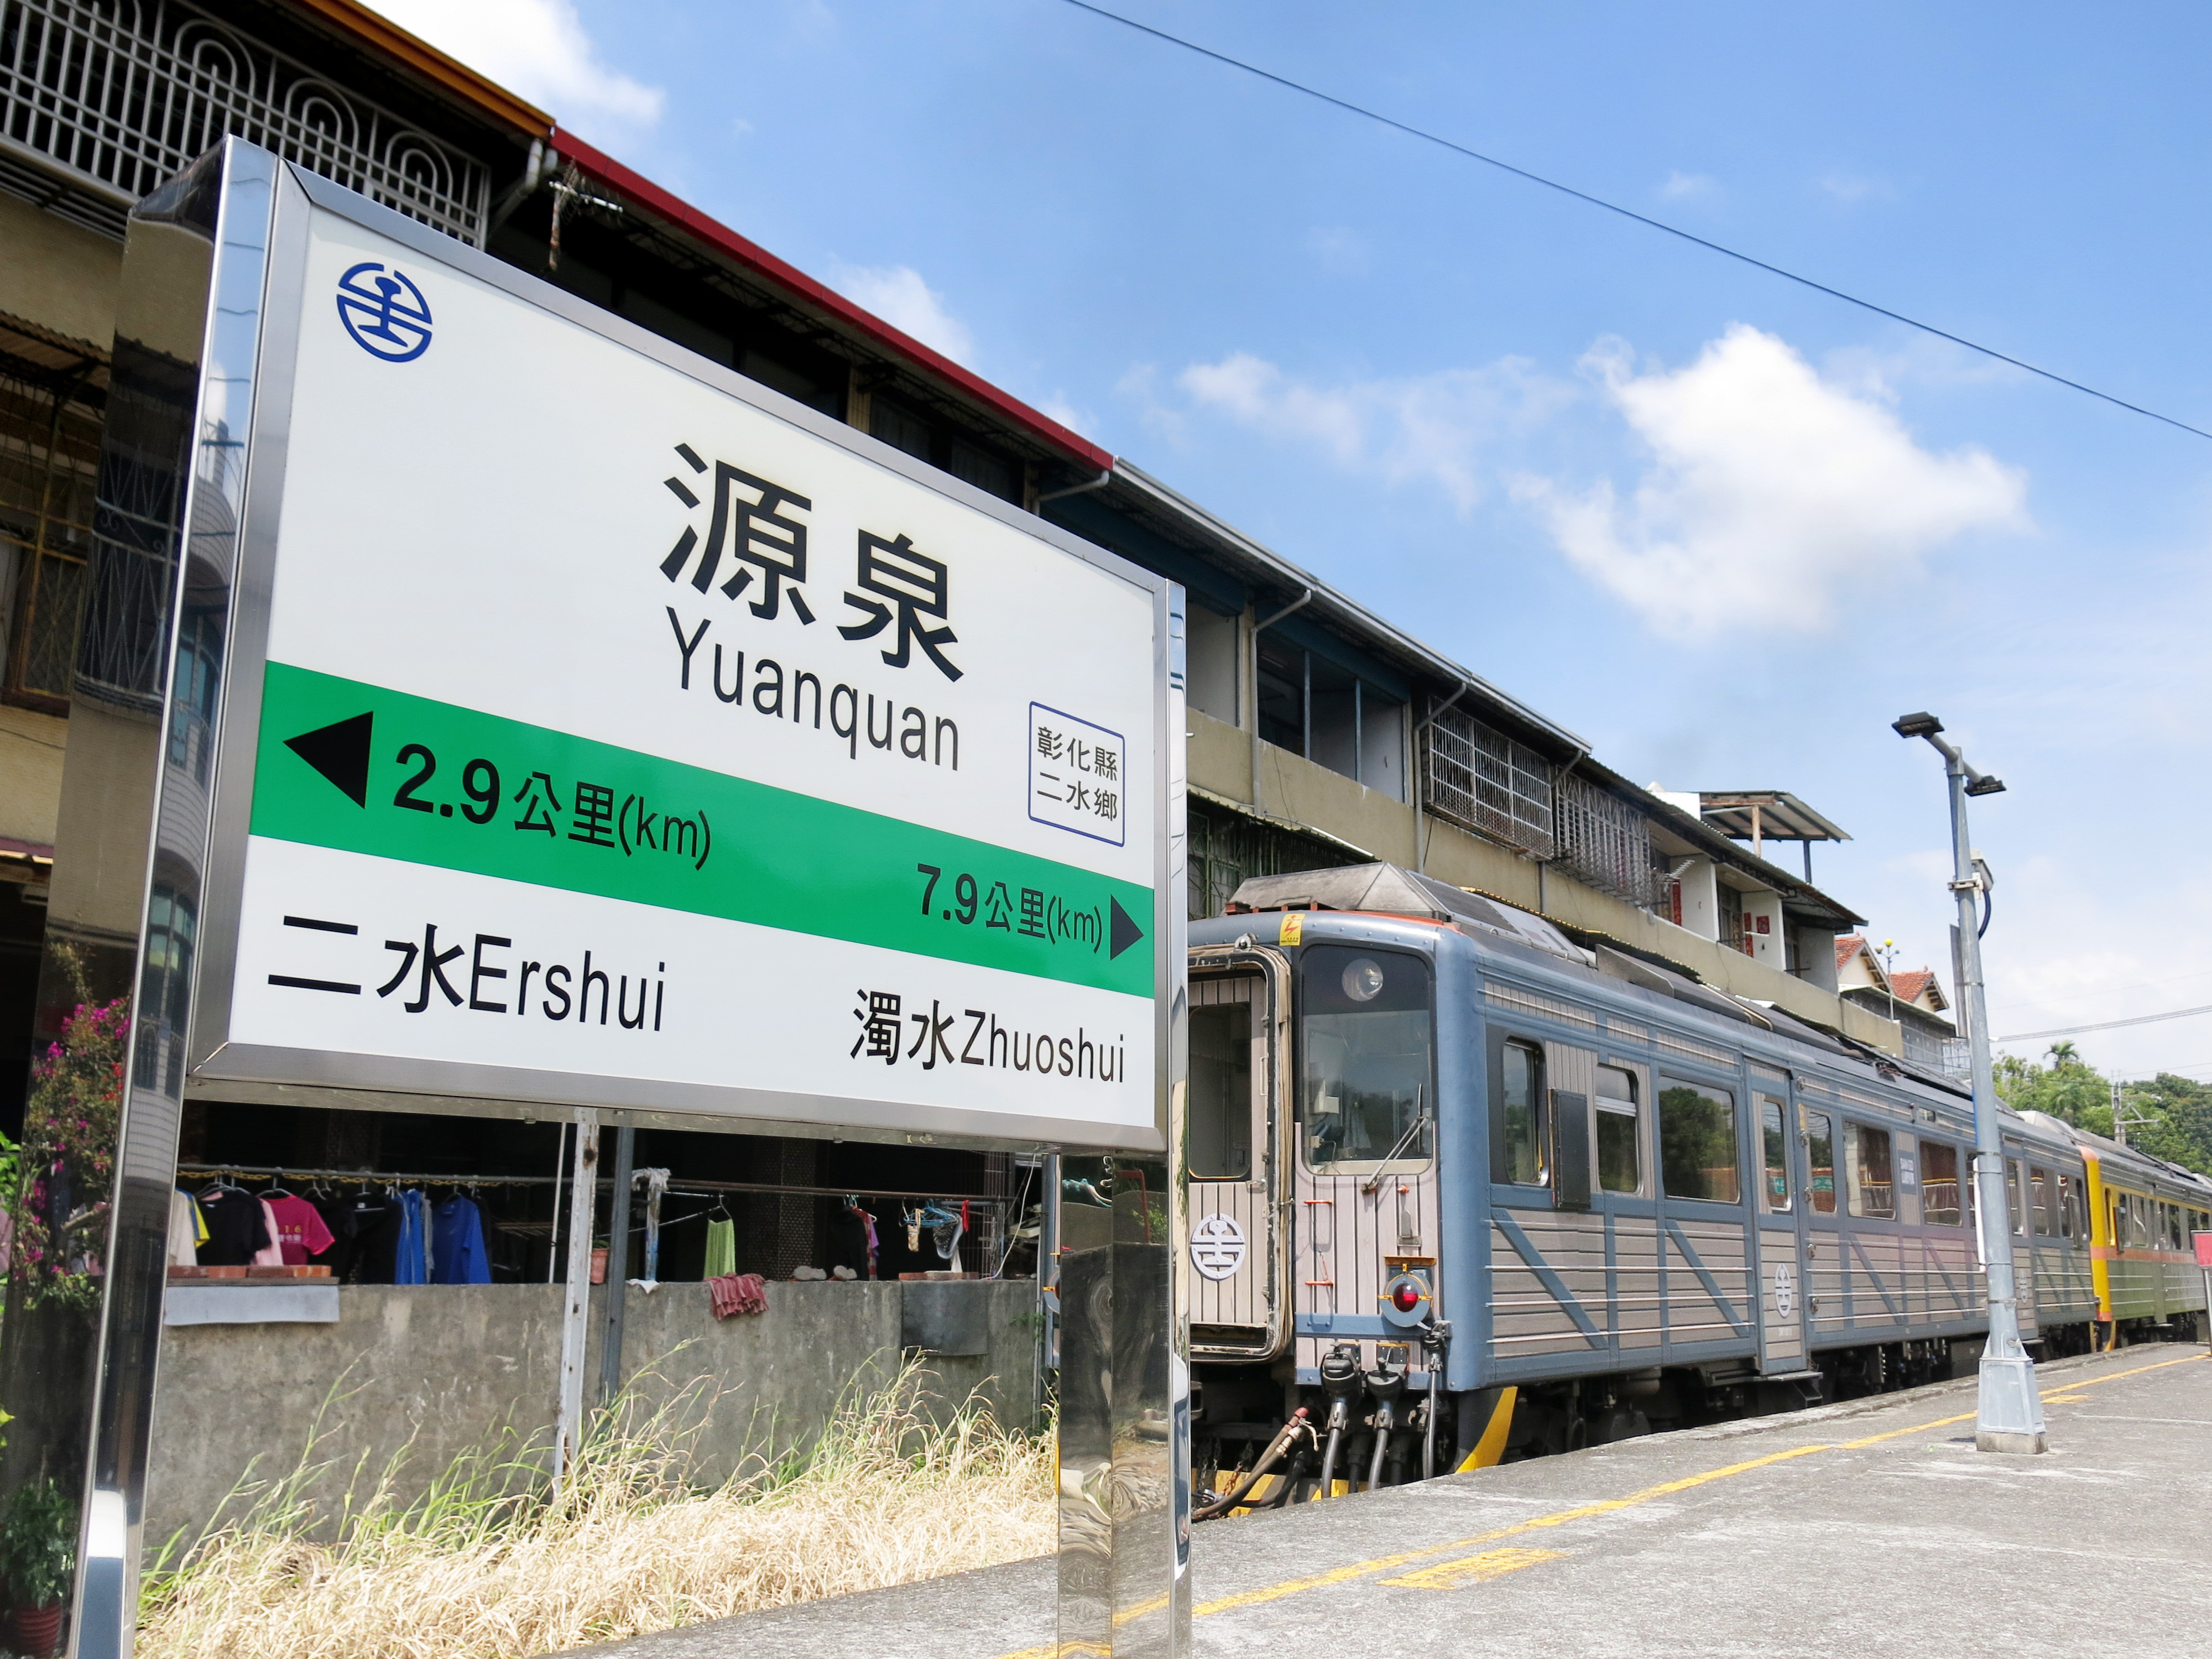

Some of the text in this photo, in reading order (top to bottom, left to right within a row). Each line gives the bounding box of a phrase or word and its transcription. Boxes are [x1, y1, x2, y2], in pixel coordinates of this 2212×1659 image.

[659, 443, 964, 682] 源泉
[665, 605, 959, 771] Yuanquan
[1036, 771, 1118, 822] 二水鄉
[1037, 726, 1118, 781] 彰化縣
